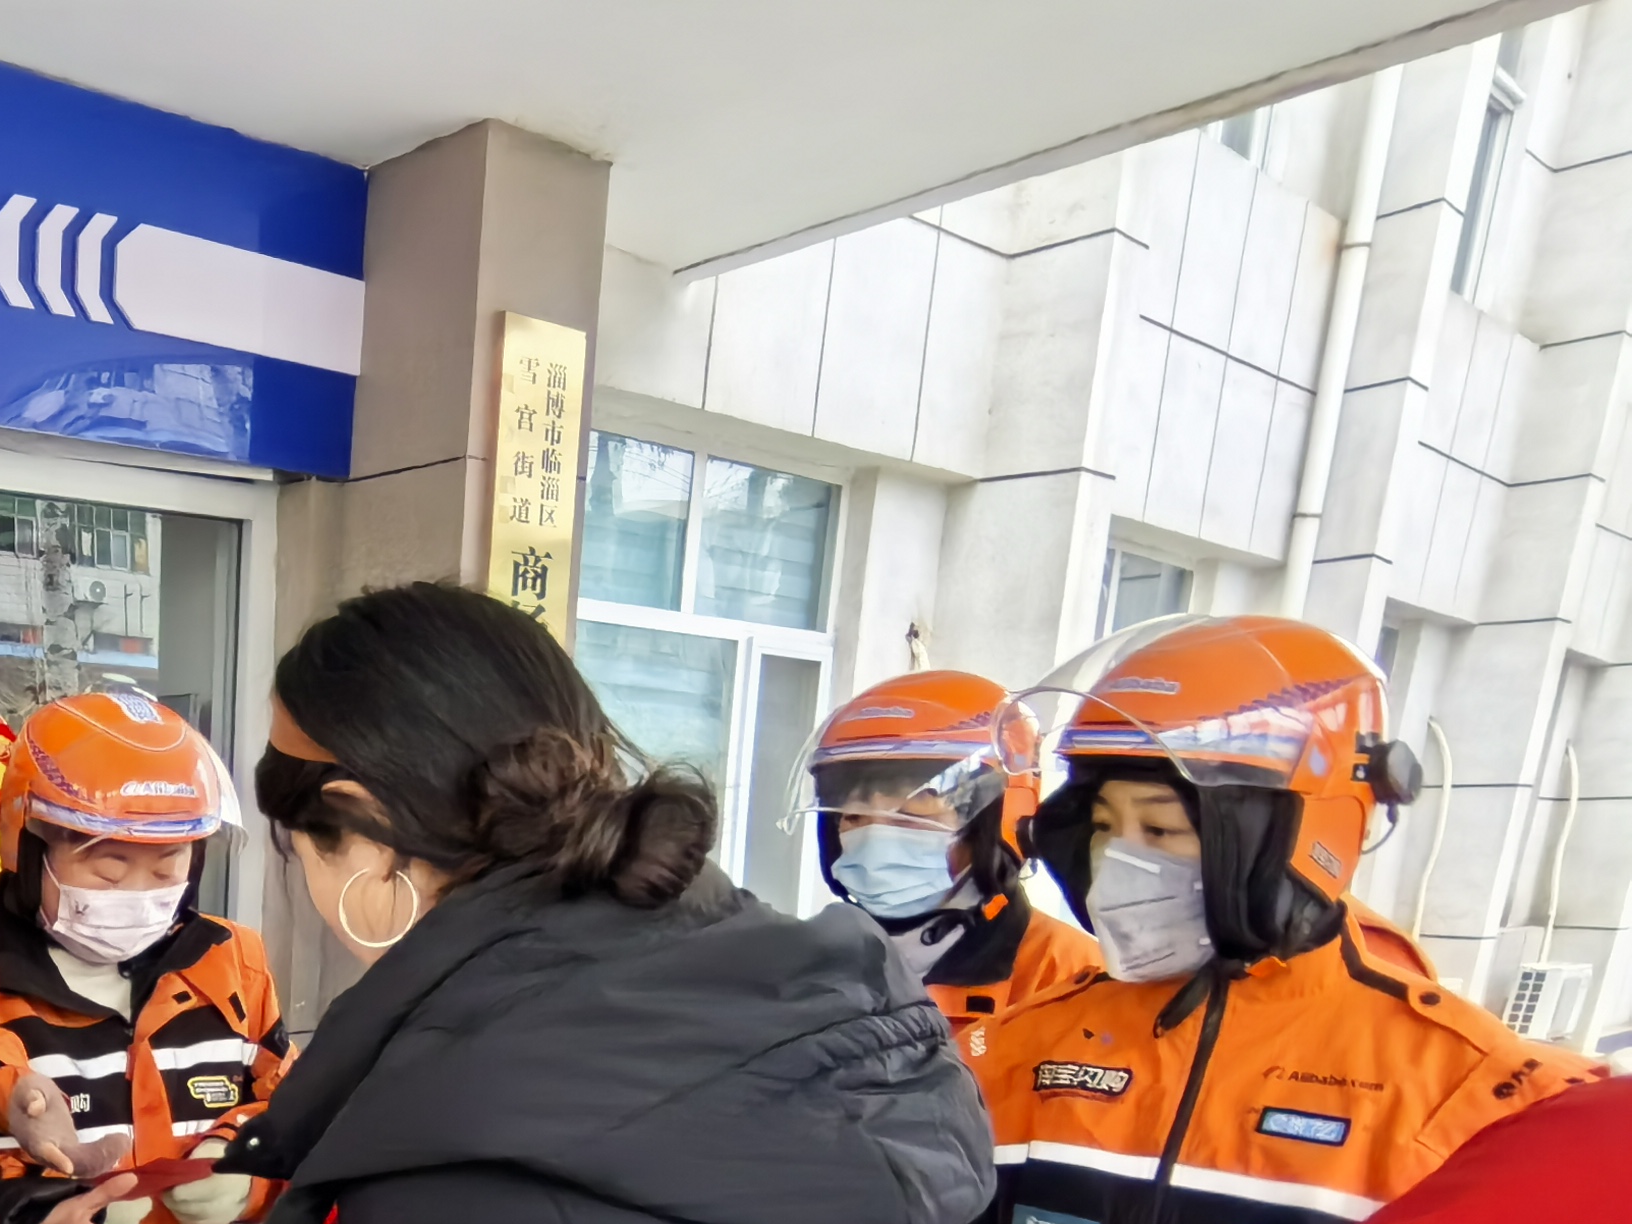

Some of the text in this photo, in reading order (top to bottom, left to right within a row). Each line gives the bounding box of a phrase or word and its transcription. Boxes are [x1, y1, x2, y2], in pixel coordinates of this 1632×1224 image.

[509, 356, 541, 524] 雪宫街道
[538, 361, 567, 529] 淄博市临淄区
